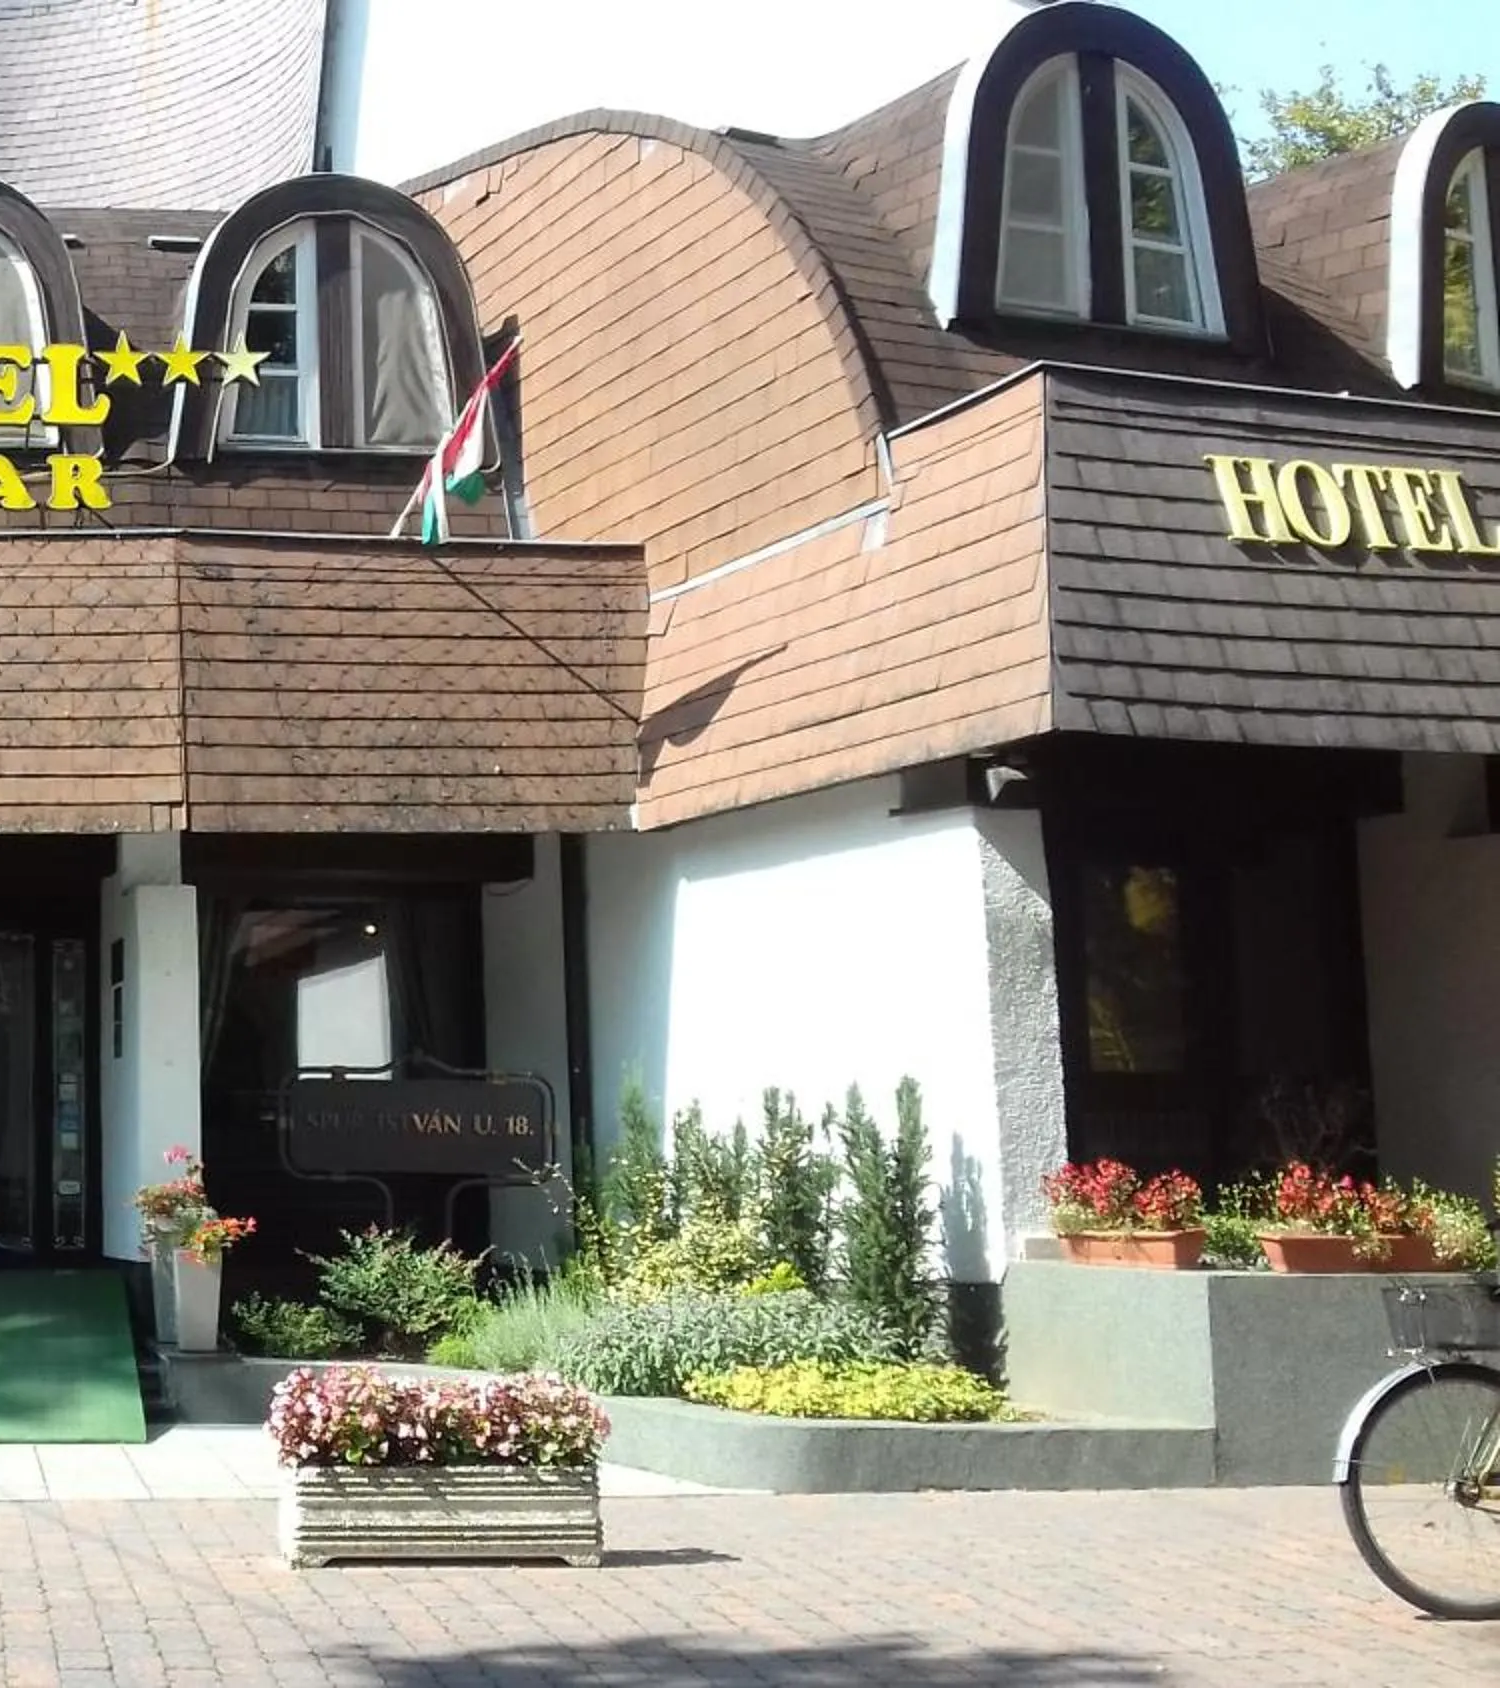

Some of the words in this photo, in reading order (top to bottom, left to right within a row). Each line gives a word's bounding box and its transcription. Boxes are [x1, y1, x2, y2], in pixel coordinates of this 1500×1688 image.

[1203, 453, 1500, 555] HOTEL
[377, 1107, 461, 1135] ISTVÁN
[473, 1115, 497, 1135] U.
[504, 1115, 534, 1136] 18.
